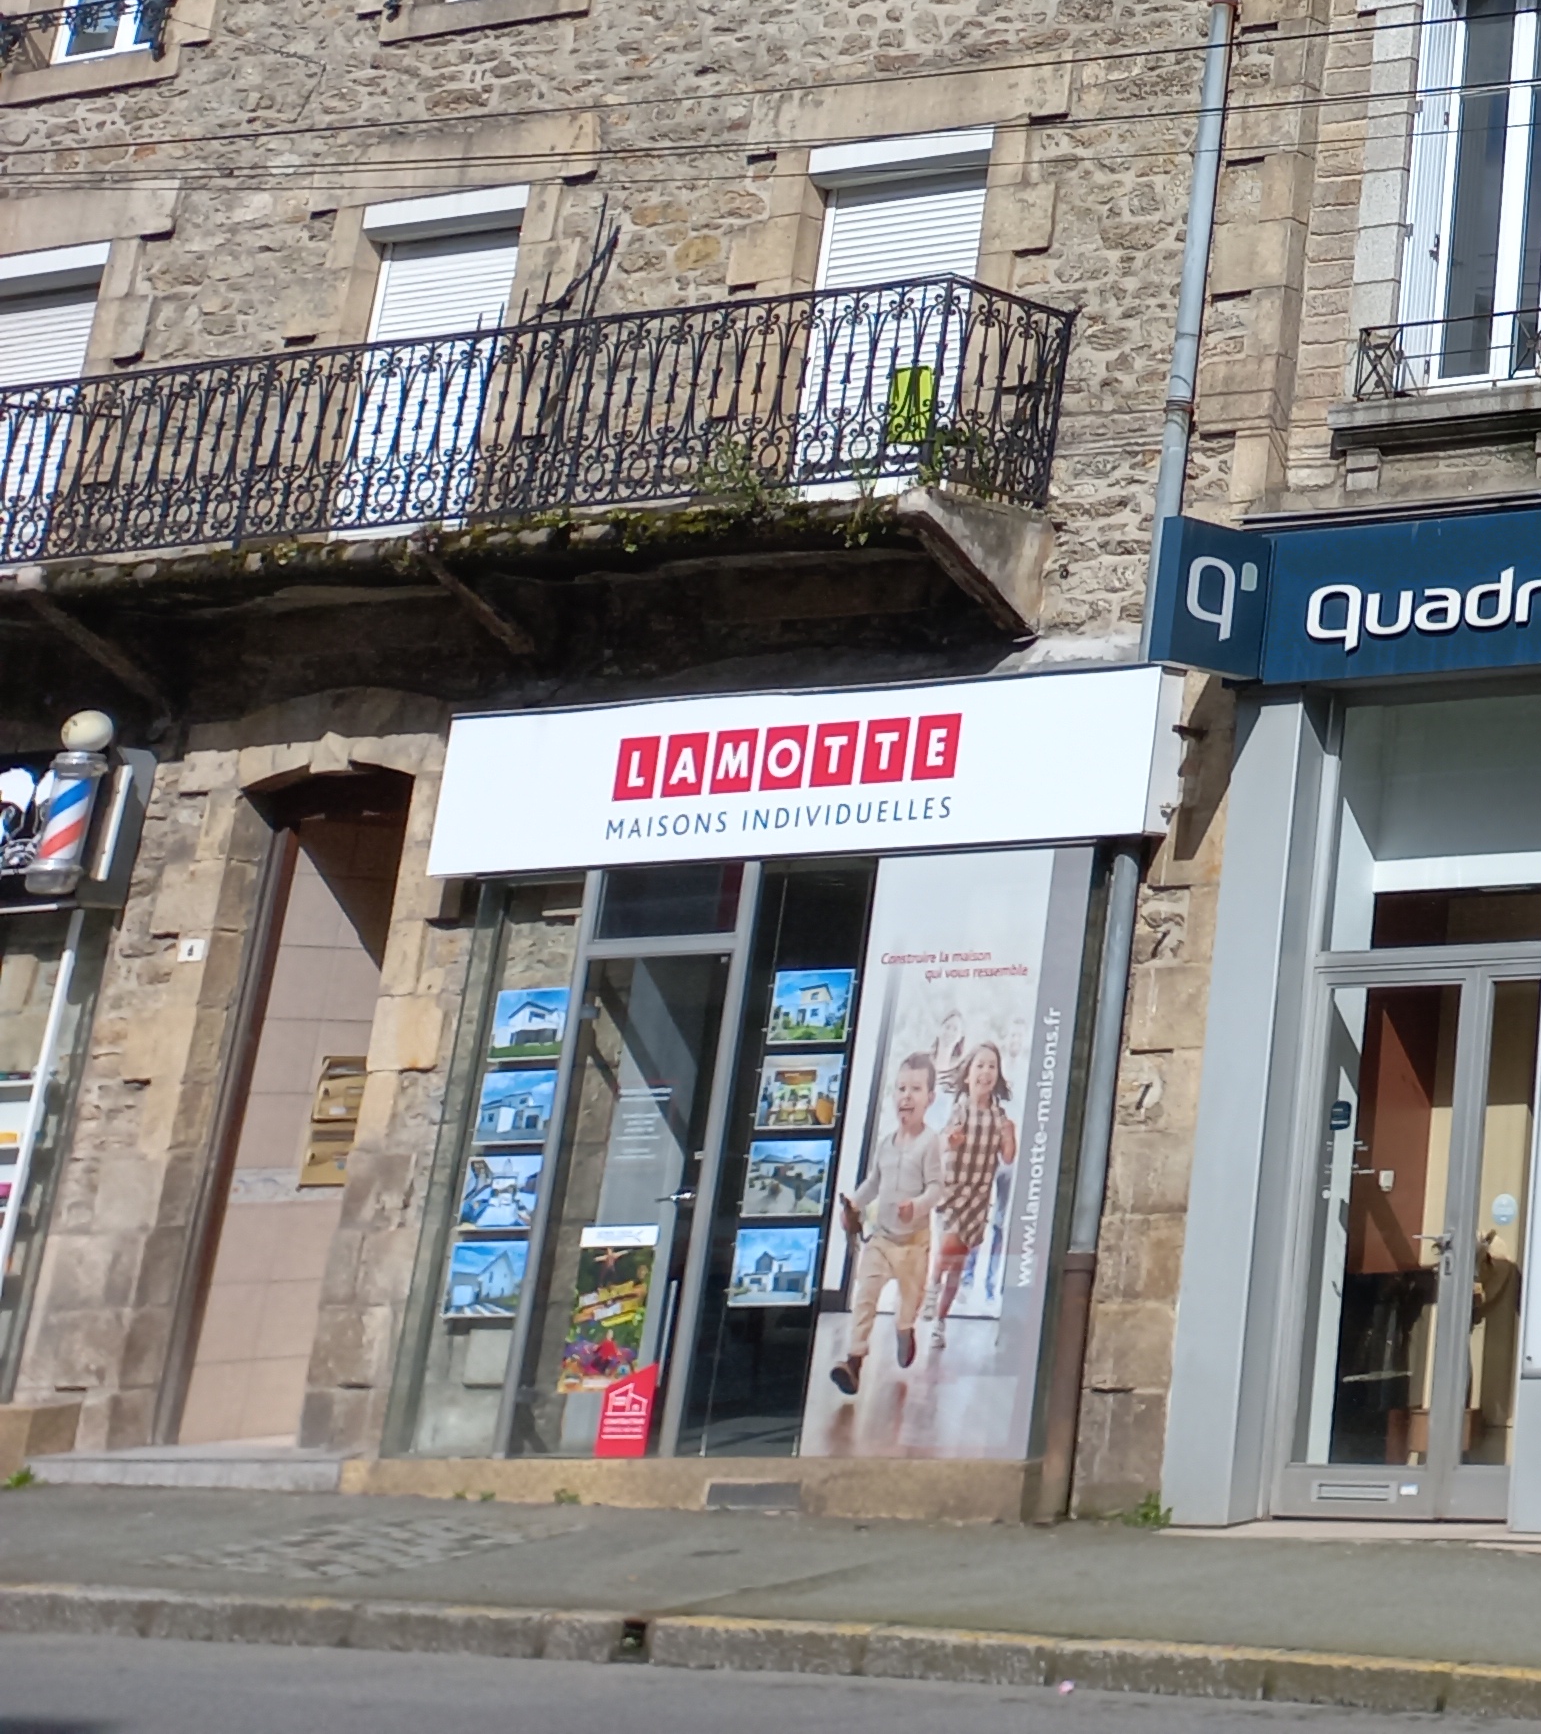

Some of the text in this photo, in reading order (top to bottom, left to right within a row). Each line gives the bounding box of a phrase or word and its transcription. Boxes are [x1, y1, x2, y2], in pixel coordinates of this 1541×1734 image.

[622, 724, 952, 792] LAMOTTE
[605, 796, 951, 840] MAISONS INDIVIDUELLES
[881, 950, 991, 964] Construire la maison
[925, 964, 1028, 983] qui vous ressemble
[1017, 1007, 1061, 1287] www.lamotte-maisons.fr
